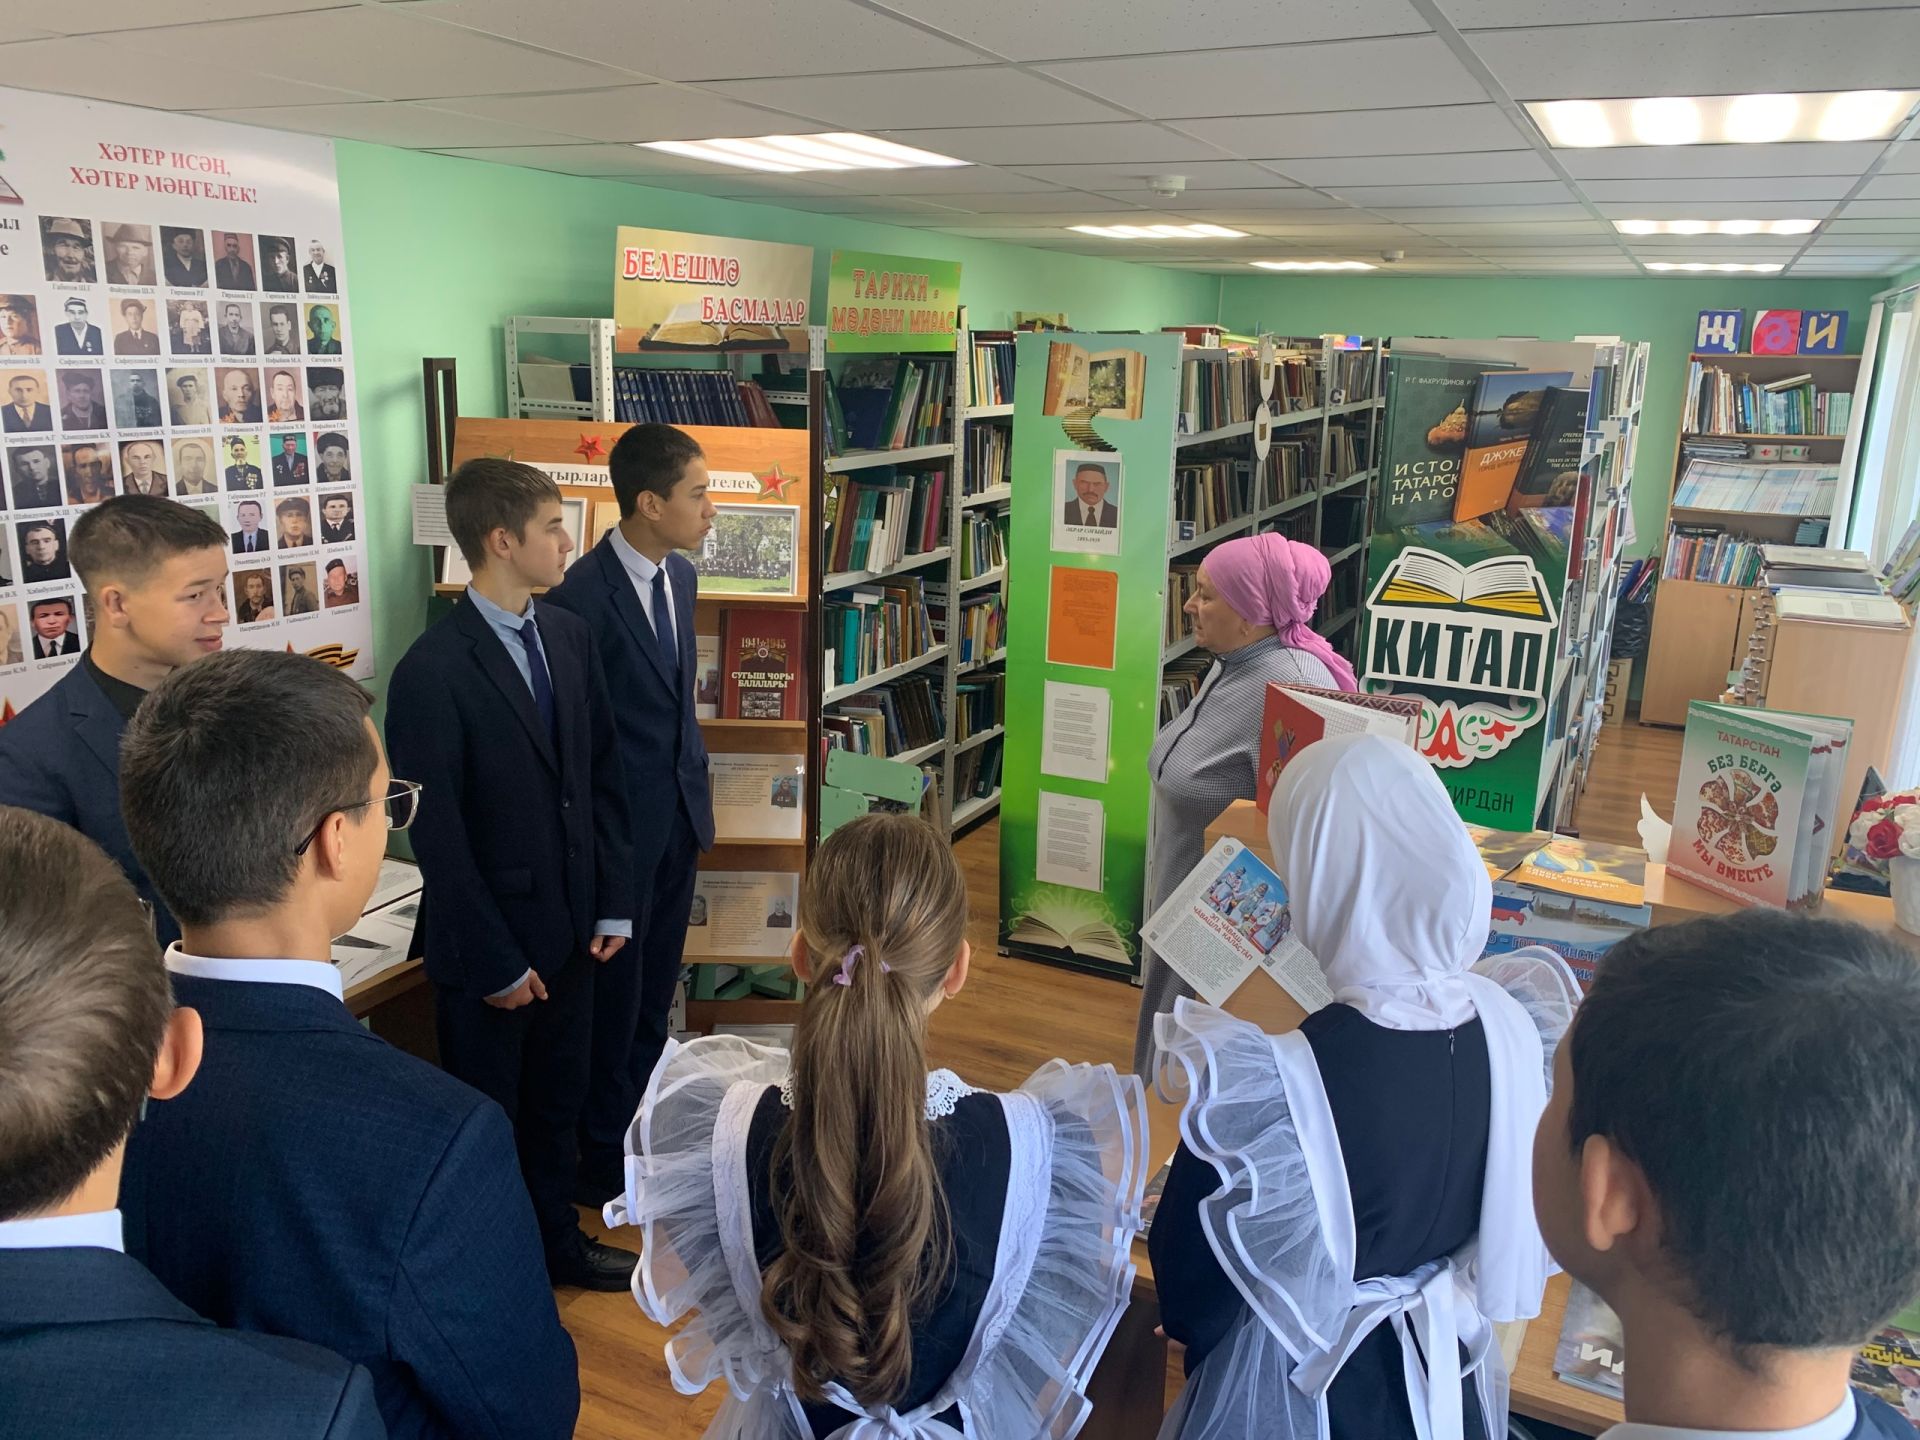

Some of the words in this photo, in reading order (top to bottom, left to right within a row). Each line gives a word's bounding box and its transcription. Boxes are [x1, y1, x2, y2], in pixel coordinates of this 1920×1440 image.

[98, 142, 165, 166] ХӘТЕР
[171, 152, 231, 177] ИСӘН,
[70, 166, 139, 190] ХӘТЕР
[145, 175, 257, 203] МӘҢГЕЛЕК!
[624, 248, 741, 284] БЕЛЕШМӘ
[853, 268, 928, 301] ТАРИХИ
[702, 296, 806, 325] БАСМАЛАР
[832, 305, 904, 336] МӘДӘНИ
[909, 309, 955, 334] МИРАС
[543, 470, 609, 485] тырлар
[1372, 617, 1543, 692] КИТАП
[731, 671, 766, 680] СУГЫШ
[768, 672, 794, 680] ЧОРЫ
[737, 679, 788, 688] БАЛАЛАРЫ
[1707, 754, 1734, 774] БЕЗ
[1740, 755, 1783, 794] БЕРГӘ
[1446, 784, 1514, 813] ИРДӘН
[1693, 839, 1715, 866] МЫ
[1716, 861, 1774, 883] ВМЕСТЕ
